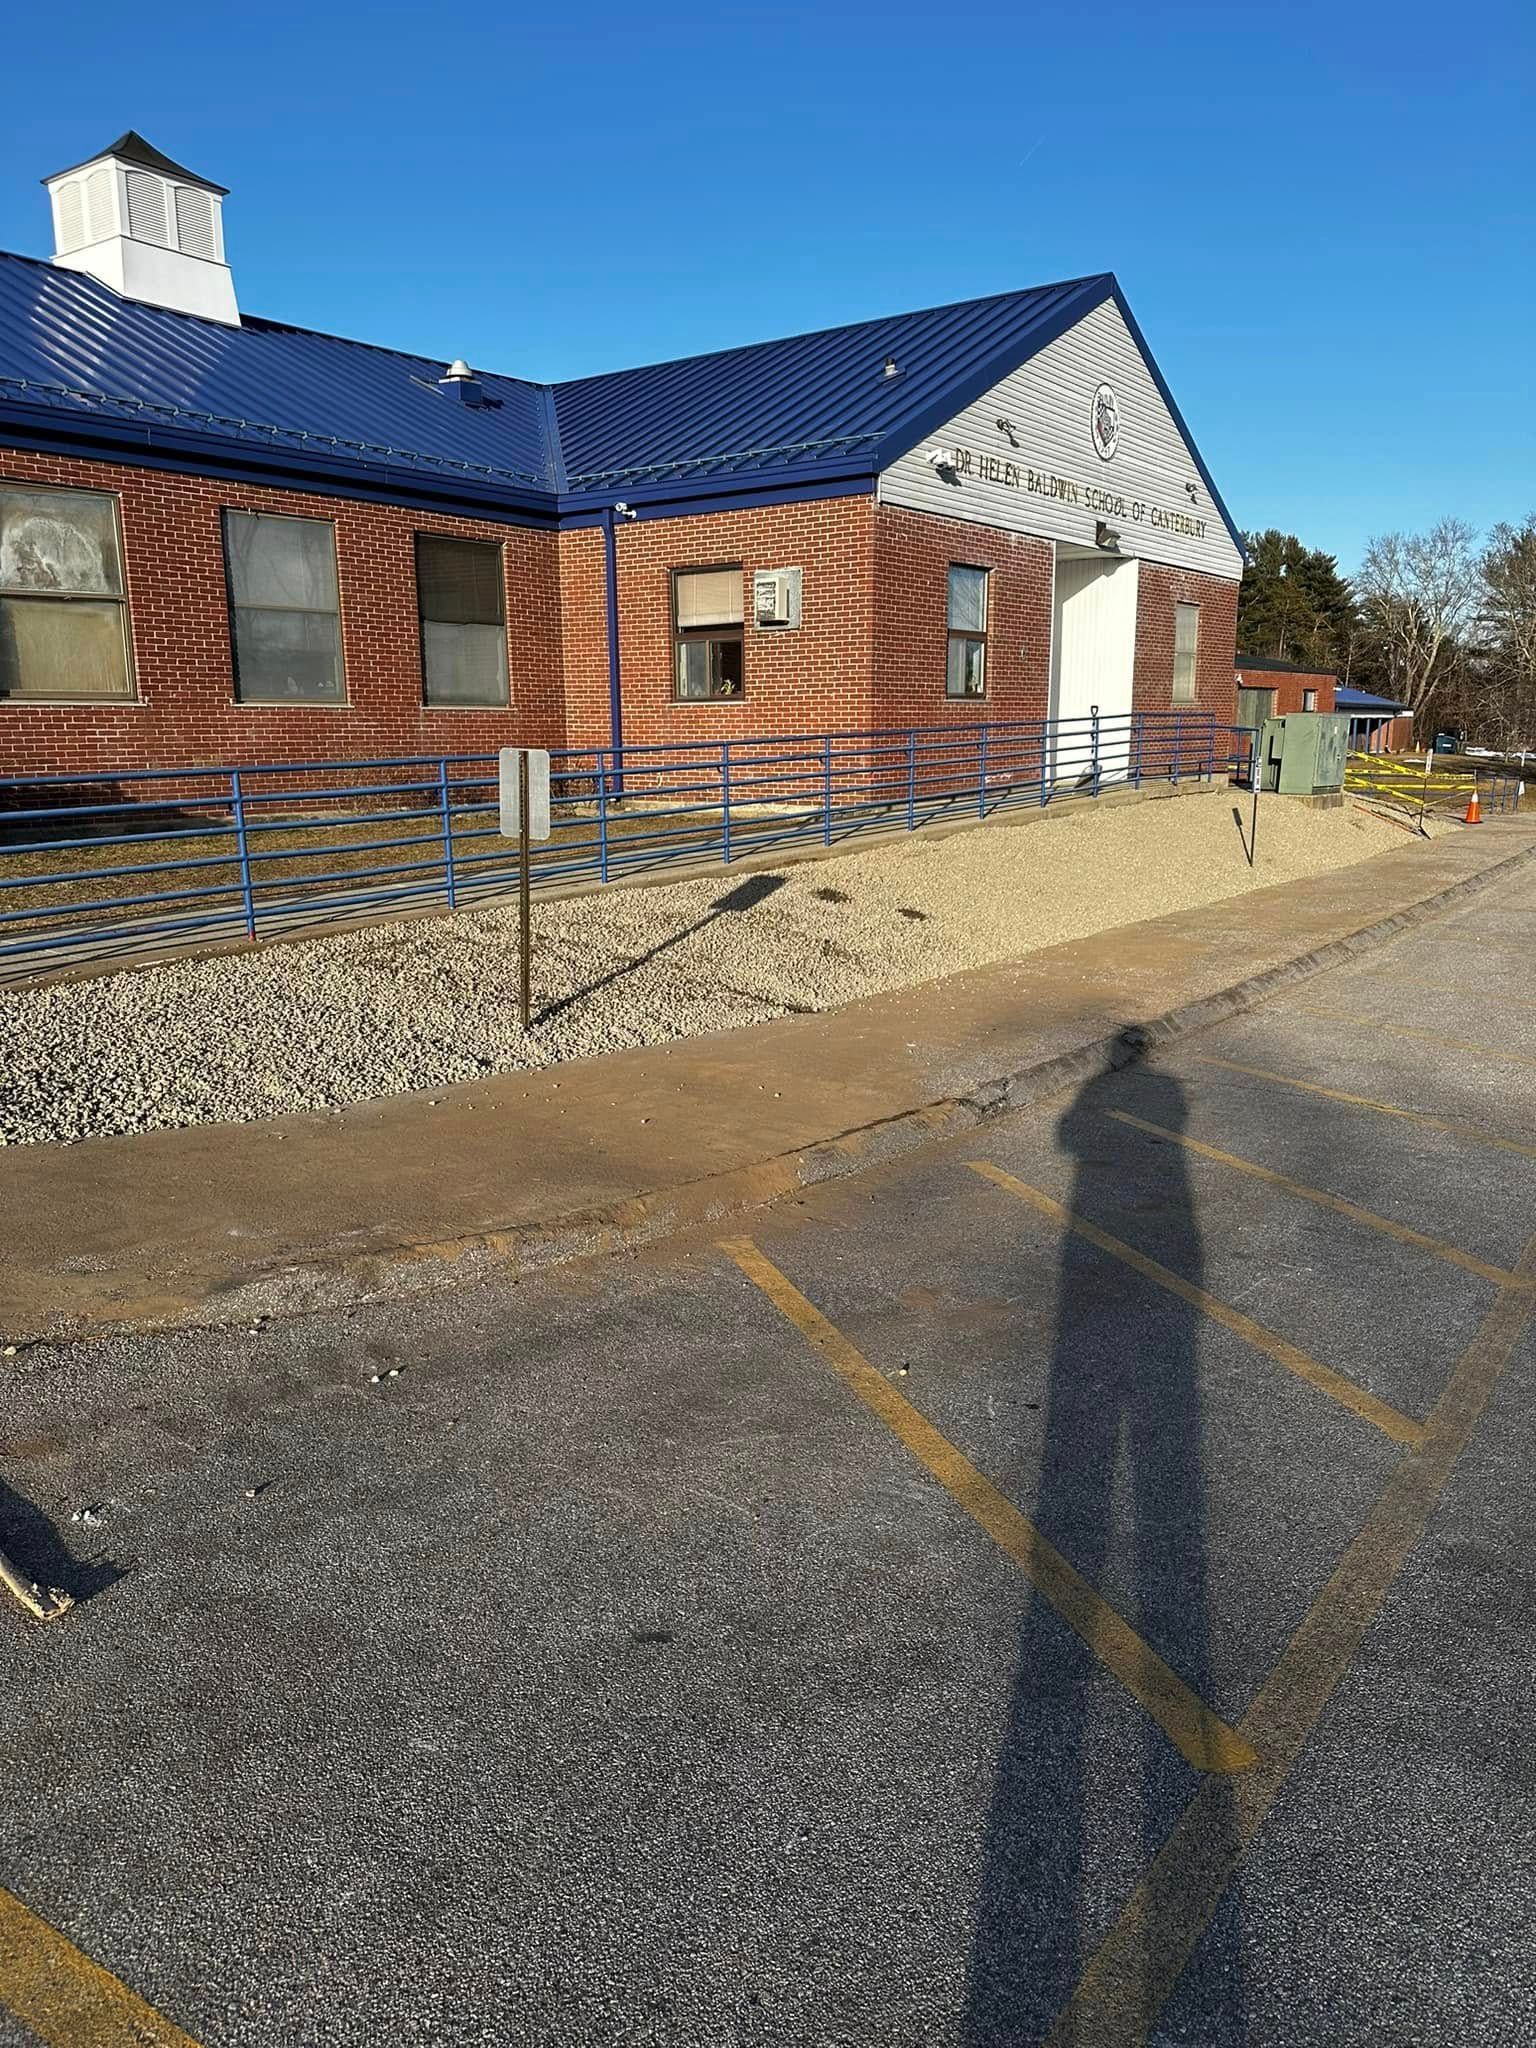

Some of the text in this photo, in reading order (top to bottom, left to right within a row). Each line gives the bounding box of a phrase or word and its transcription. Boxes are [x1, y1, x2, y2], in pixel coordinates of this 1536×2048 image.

[955, 447, 1206, 538] DR HELEN BALDWIN SCHOOL OF CANTERBURY
